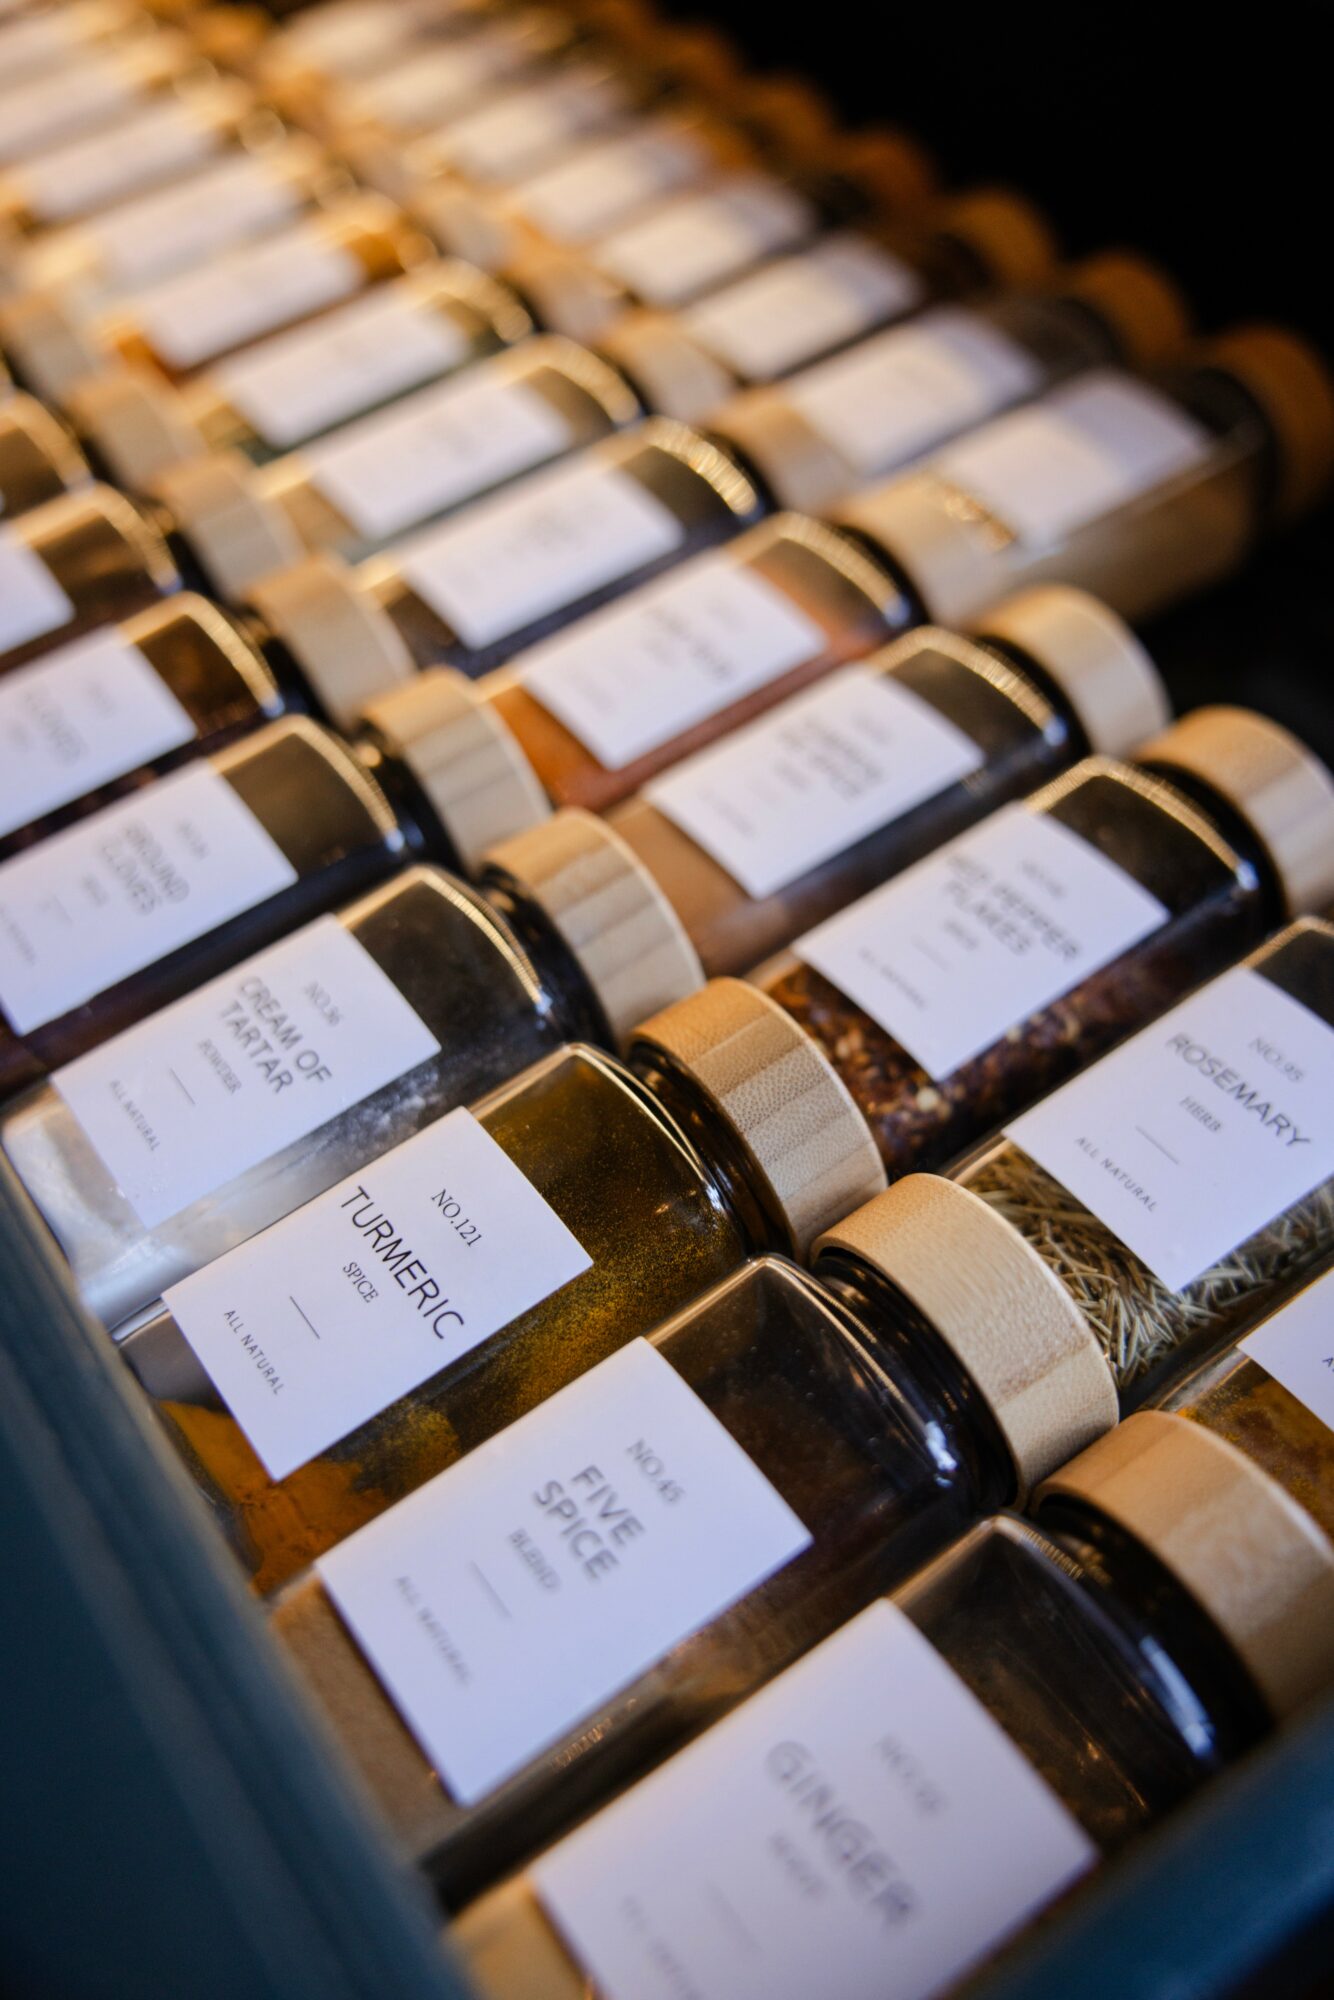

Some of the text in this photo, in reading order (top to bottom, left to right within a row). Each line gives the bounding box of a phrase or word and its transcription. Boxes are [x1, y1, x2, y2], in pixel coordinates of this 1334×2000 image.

[199, 1039, 242, 1095] POWDER
[220, 1000, 294, 1095] TARTAR
[240, 977, 333, 1083] CREAM OF
[109, 1079, 161, 1152] ALL NATURAL
[1166, 1032, 1311, 1148] ROSEMARY
[1178, 1095, 1223, 1134] HERB
[1074, 1135, 1158, 1212] ALL NATURAL
[430, 1187, 483, 1248] NO.121
[340, 1185, 465, 1340] TURMERIC
[342, 1261, 380, 1303] SPICE
[223, 1309, 285, 1395] ALL NATURAL
[532, 1479, 621, 1580] SPICE
[570, 1464, 646, 1547] FIVE
[507, 1527, 562, 1592] BLEND
[763, 1740, 922, 1930] GINGER
